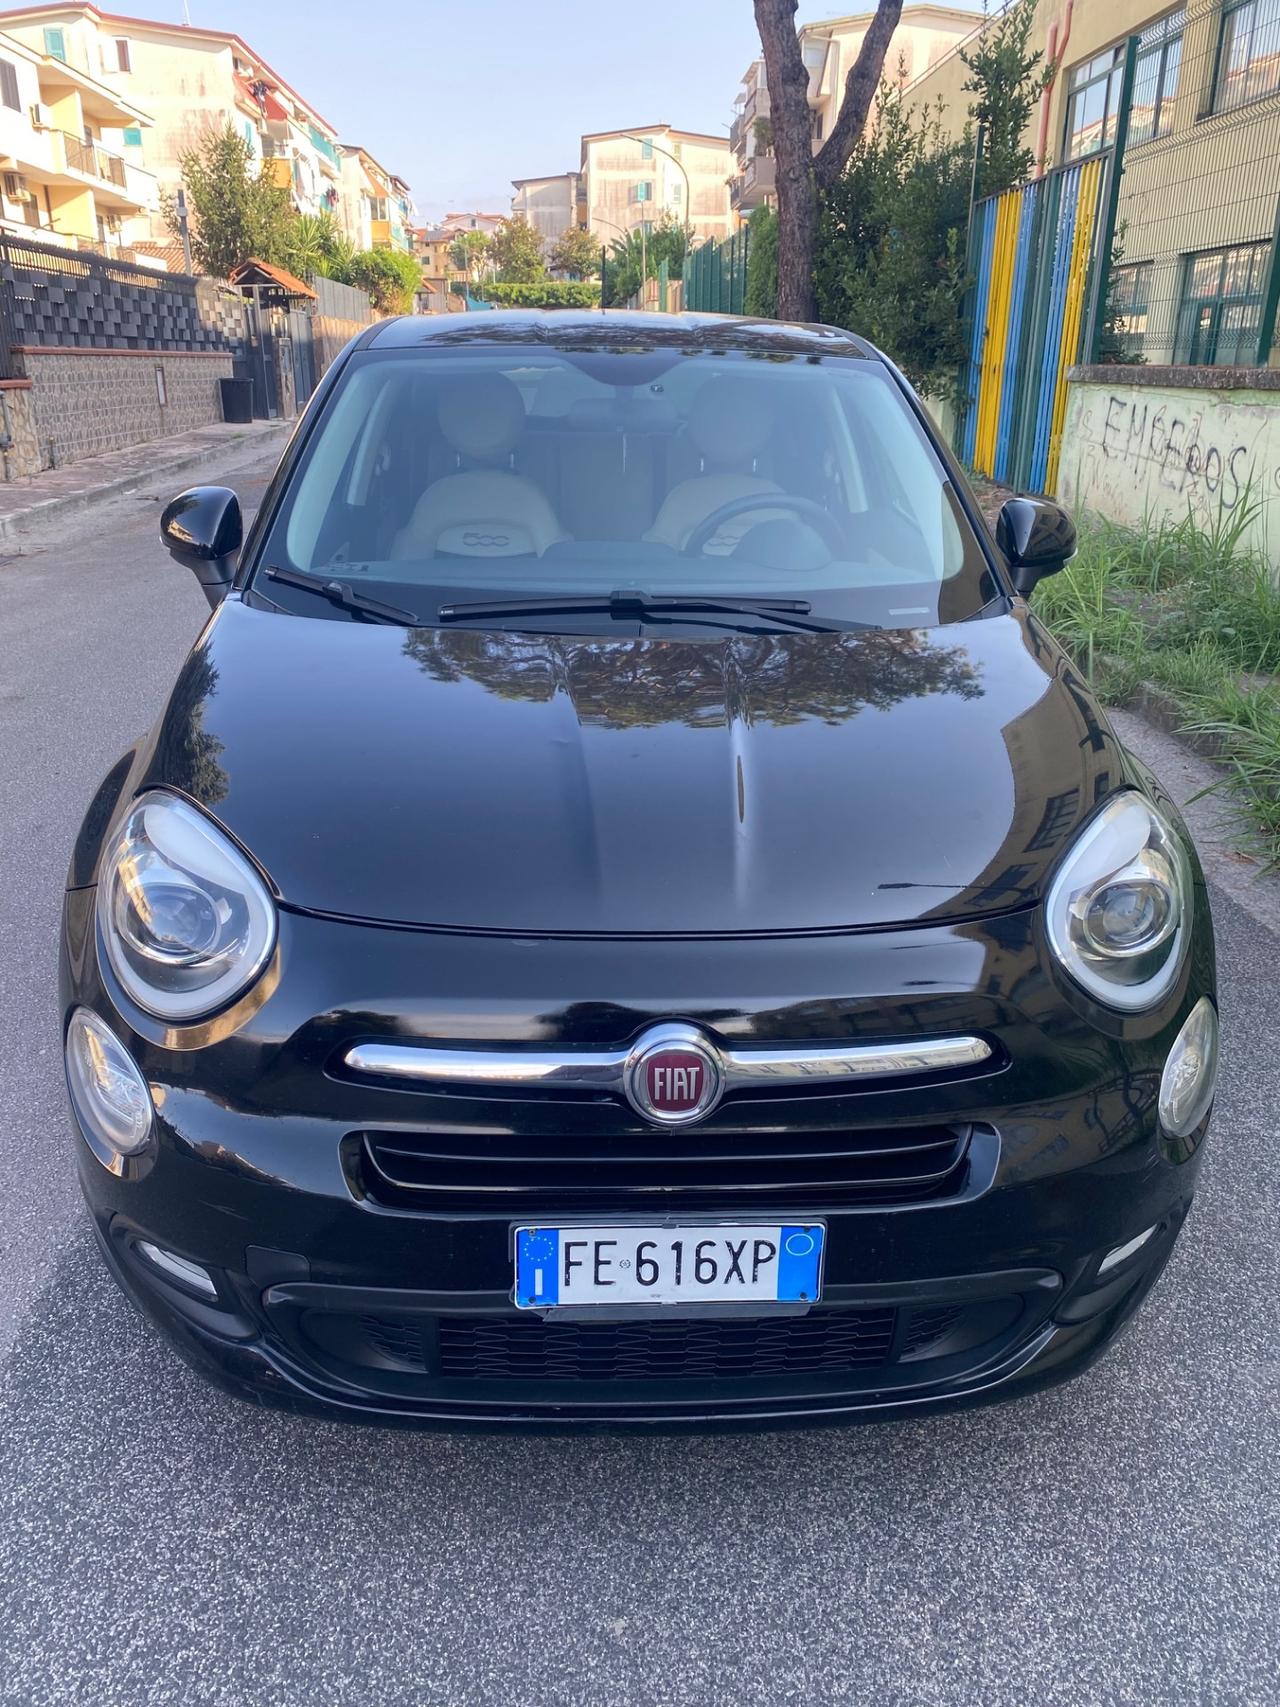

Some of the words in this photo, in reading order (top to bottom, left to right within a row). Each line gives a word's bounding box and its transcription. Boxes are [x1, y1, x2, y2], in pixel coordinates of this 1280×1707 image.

[654, 1066, 700, 1101] FIAT
[564, 1240, 617, 1287] FE
[636, 1239, 777, 1287] 616XP
